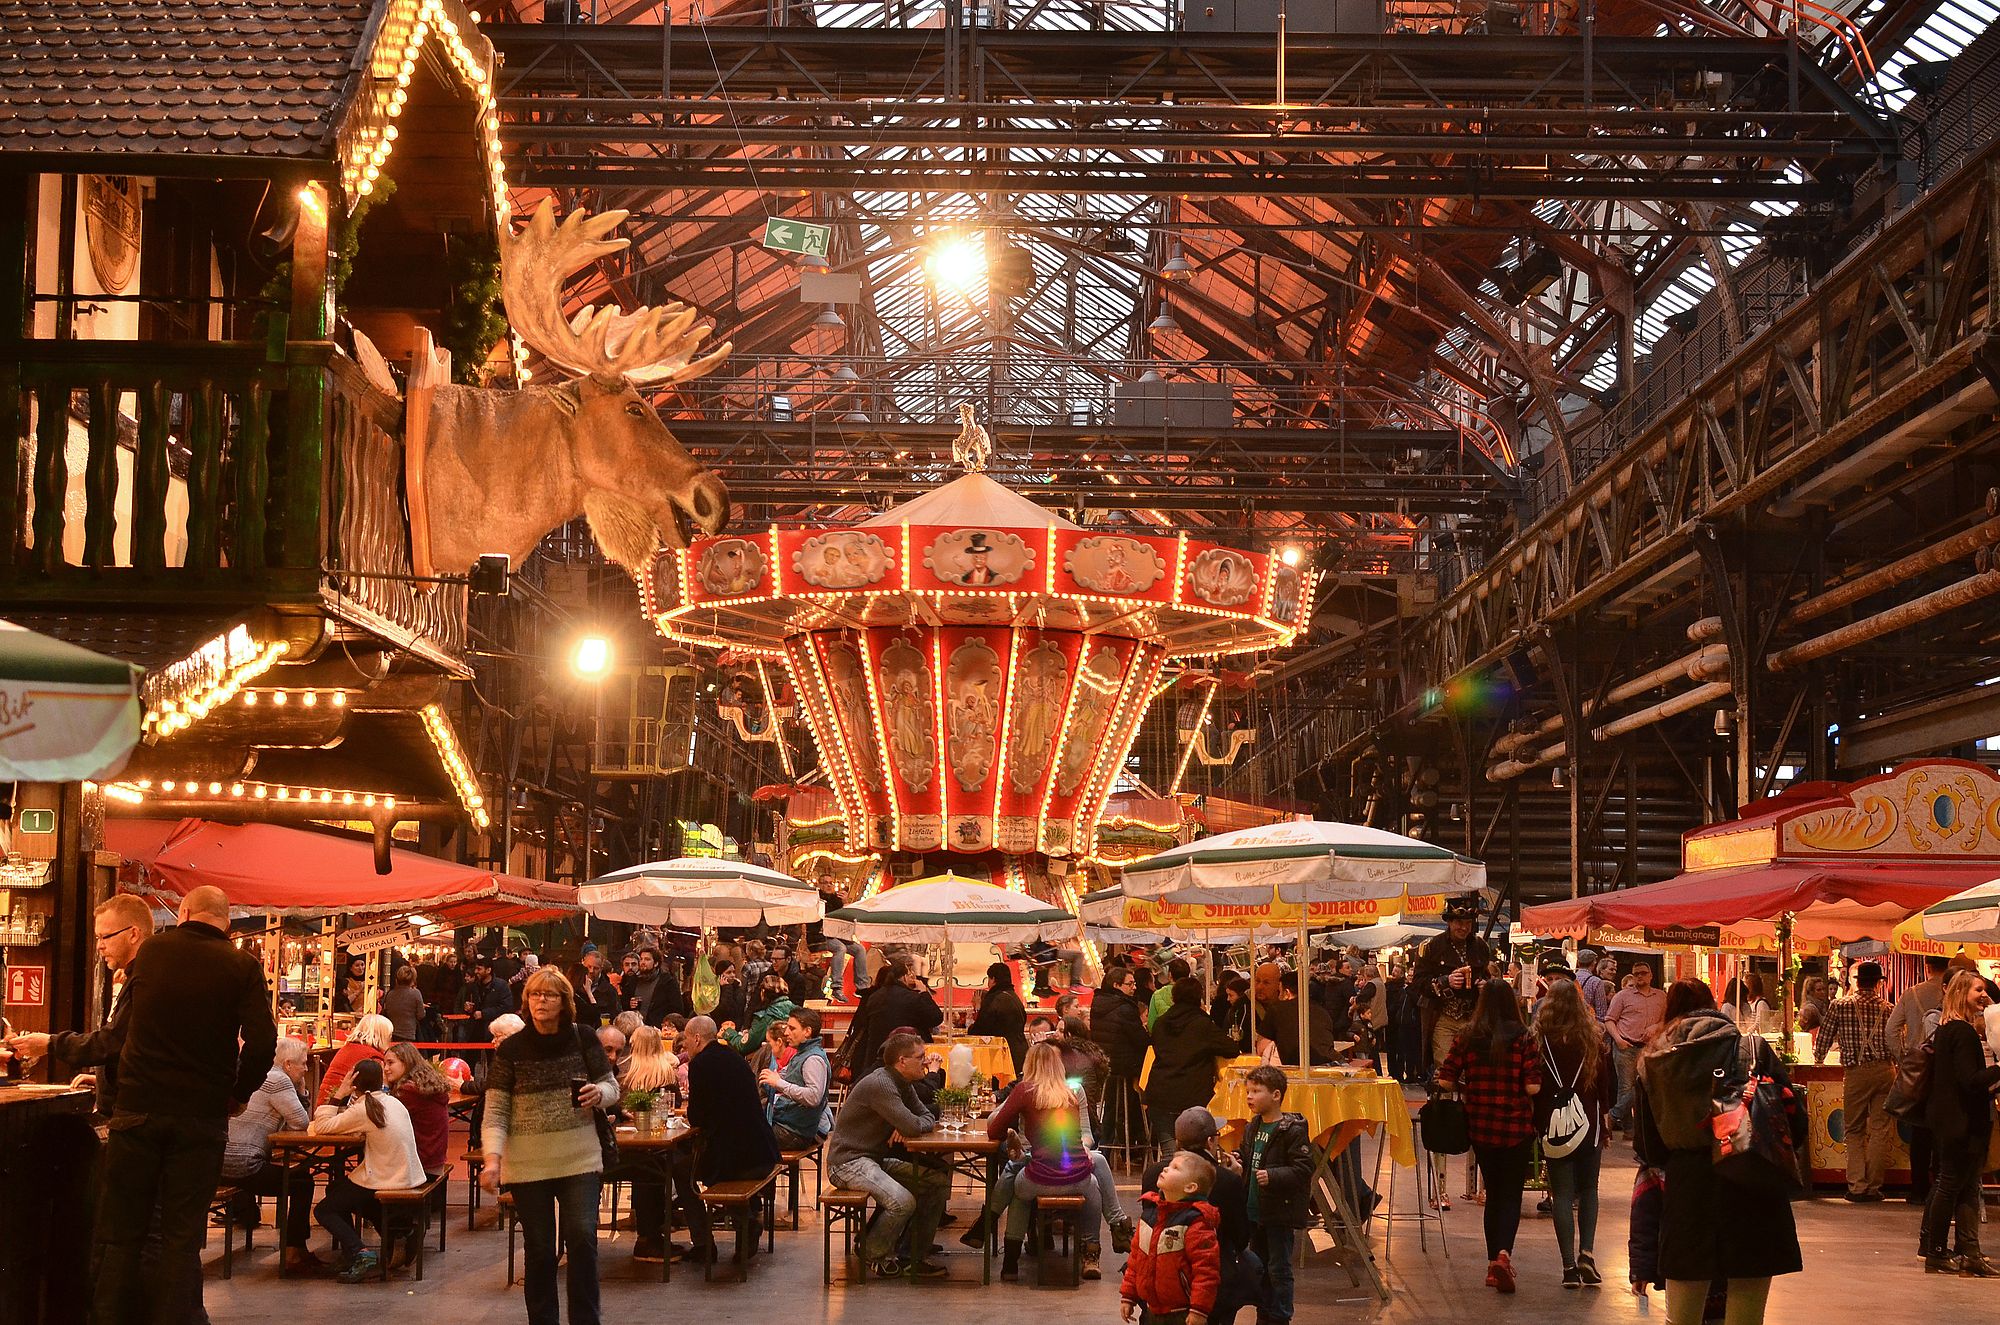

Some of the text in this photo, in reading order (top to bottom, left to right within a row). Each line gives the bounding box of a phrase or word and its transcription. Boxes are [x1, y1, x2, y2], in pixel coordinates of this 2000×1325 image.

[33, 813, 40, 829] 1
[1235, 872, 1256, 881] Bitte
[1273, 861, 1290, 872] Bit
[1368, 868, 1385, 879] Bitte
[1400, 862, 1414, 871] Bit
[1407, 896, 1437, 912] Sinalco
[347, 920, 410, 940] VERKAUF 2
[1595, 931, 1646, 945] Maiskolben
[356, 932, 410, 951] VERKAUF 1
[1721, 934, 1745, 946] alco
[1900, 933, 1945, 954] Sinalco
